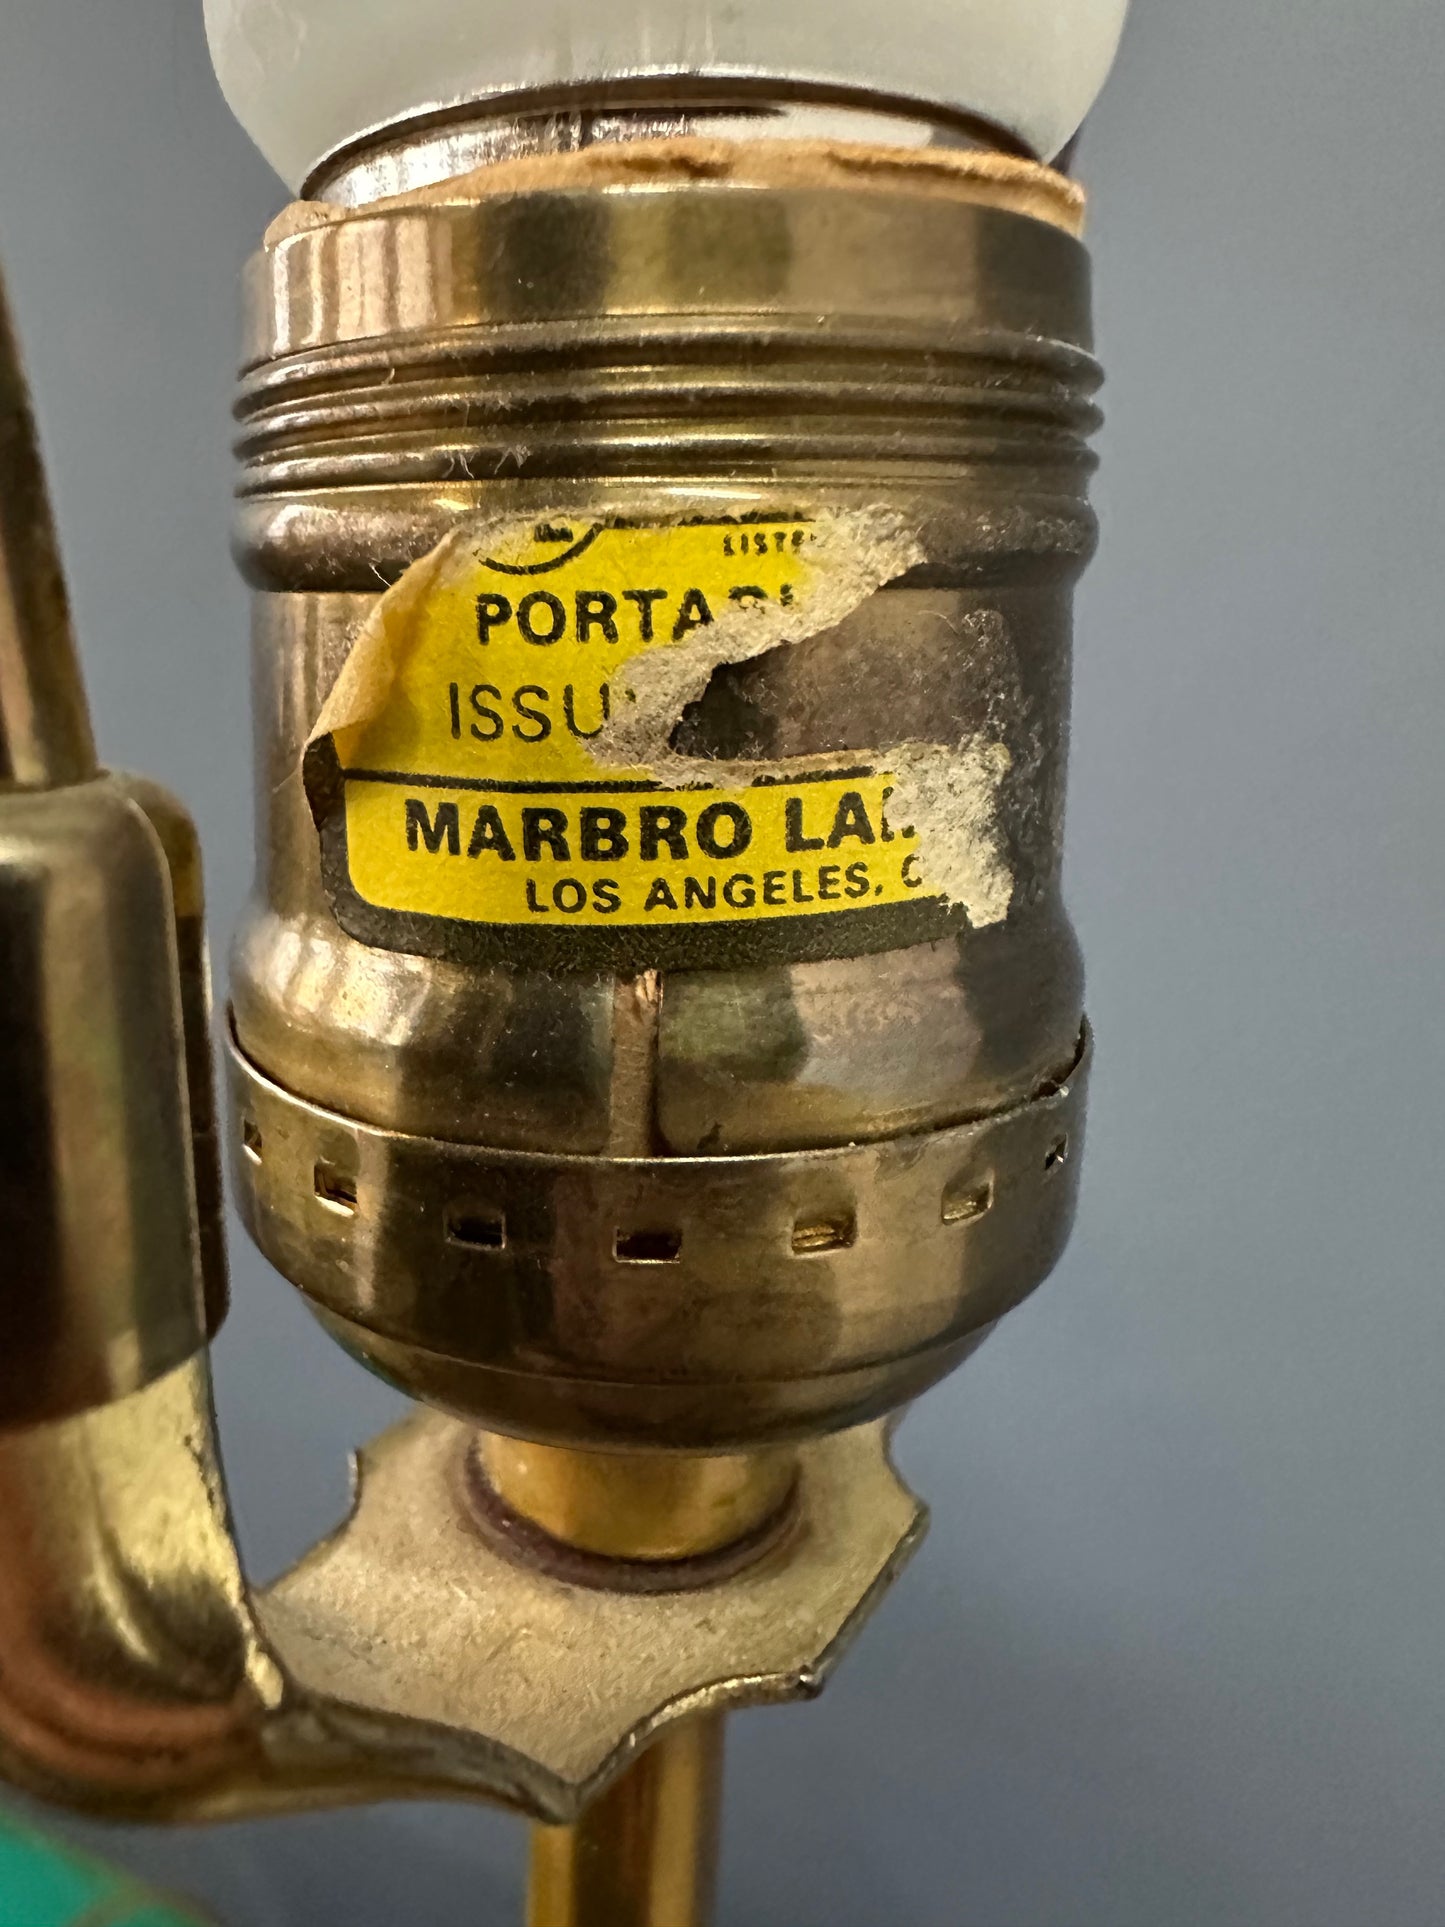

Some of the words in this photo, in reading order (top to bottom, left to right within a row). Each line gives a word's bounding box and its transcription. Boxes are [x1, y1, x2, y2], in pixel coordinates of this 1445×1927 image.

[475, 584, 794, 646] PORTA
[449, 682, 636, 743] ISSU
[405, 799, 752, 862] MARBRO
[526, 877, 622, 914] LOS
[901, 853, 924, 888] C
